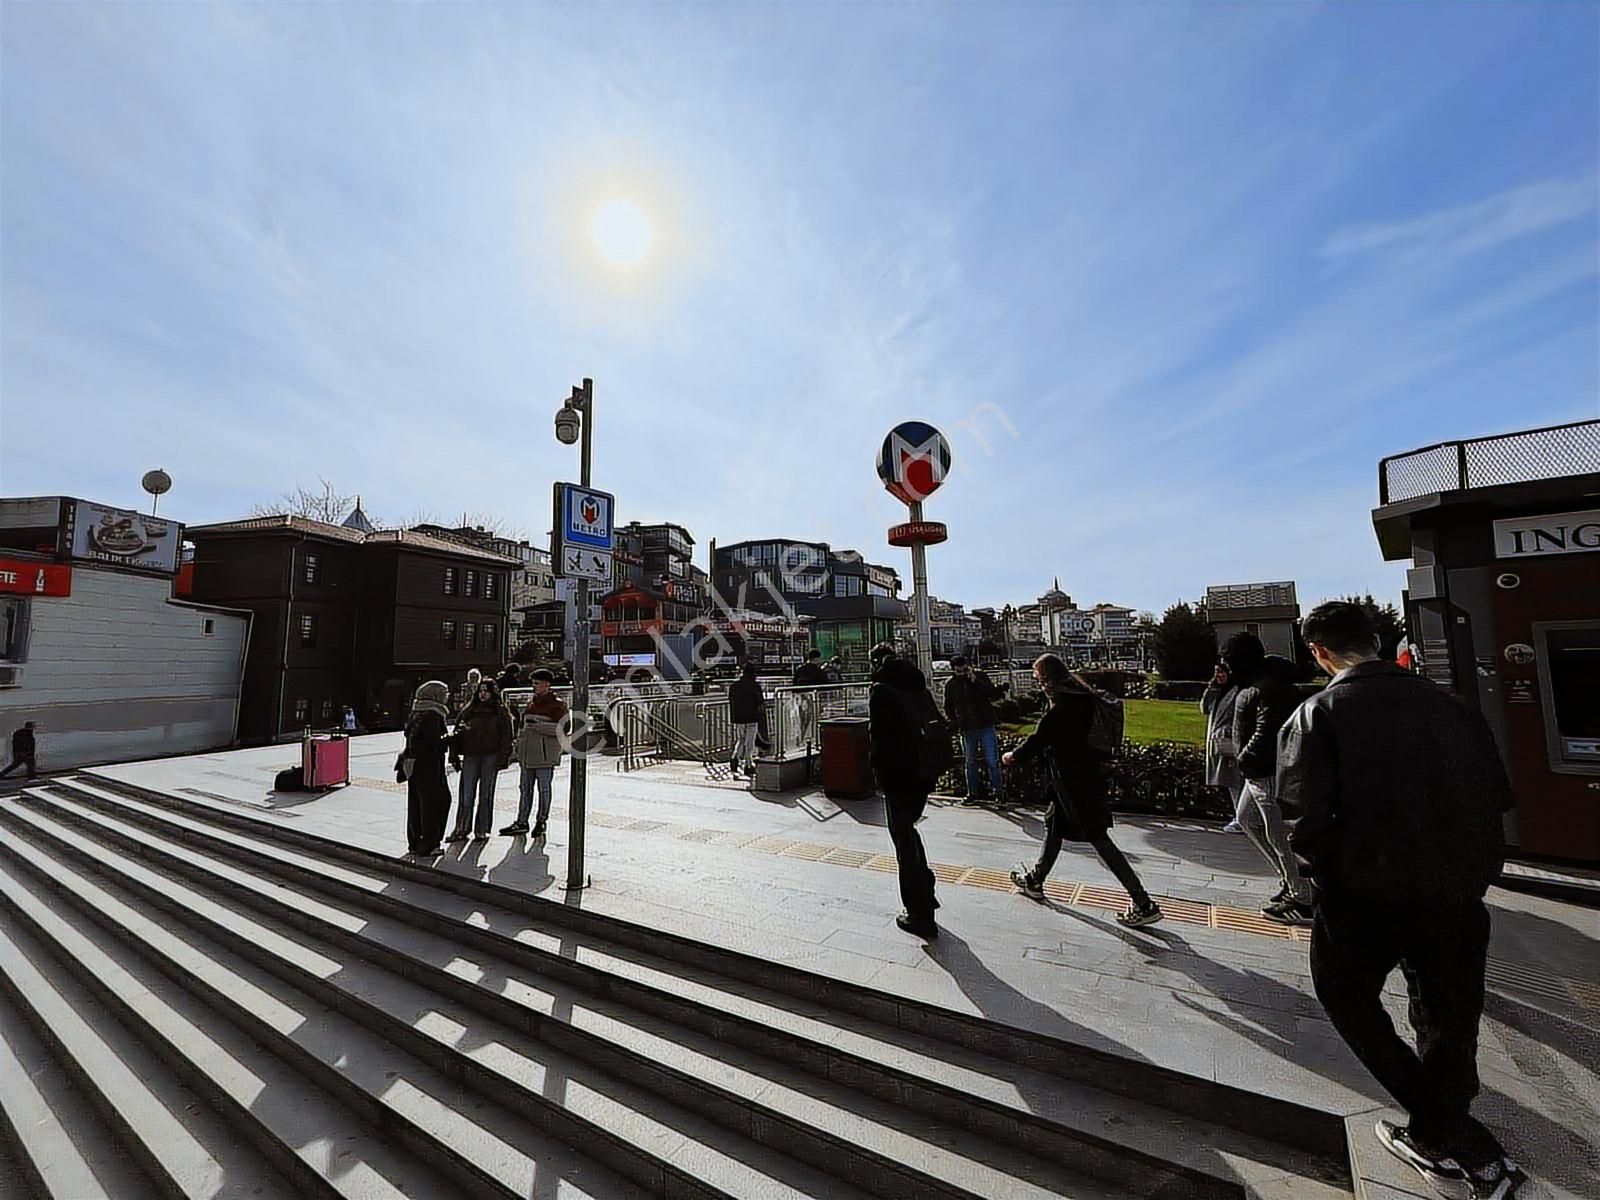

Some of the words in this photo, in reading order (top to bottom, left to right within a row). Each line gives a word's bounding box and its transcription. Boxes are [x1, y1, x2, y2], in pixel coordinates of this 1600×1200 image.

[891, 431, 942, 483] M
[573, 522, 606, 536] METRO
[1509, 522, 1600, 553] ING
[0, 570, 17, 584] TE
